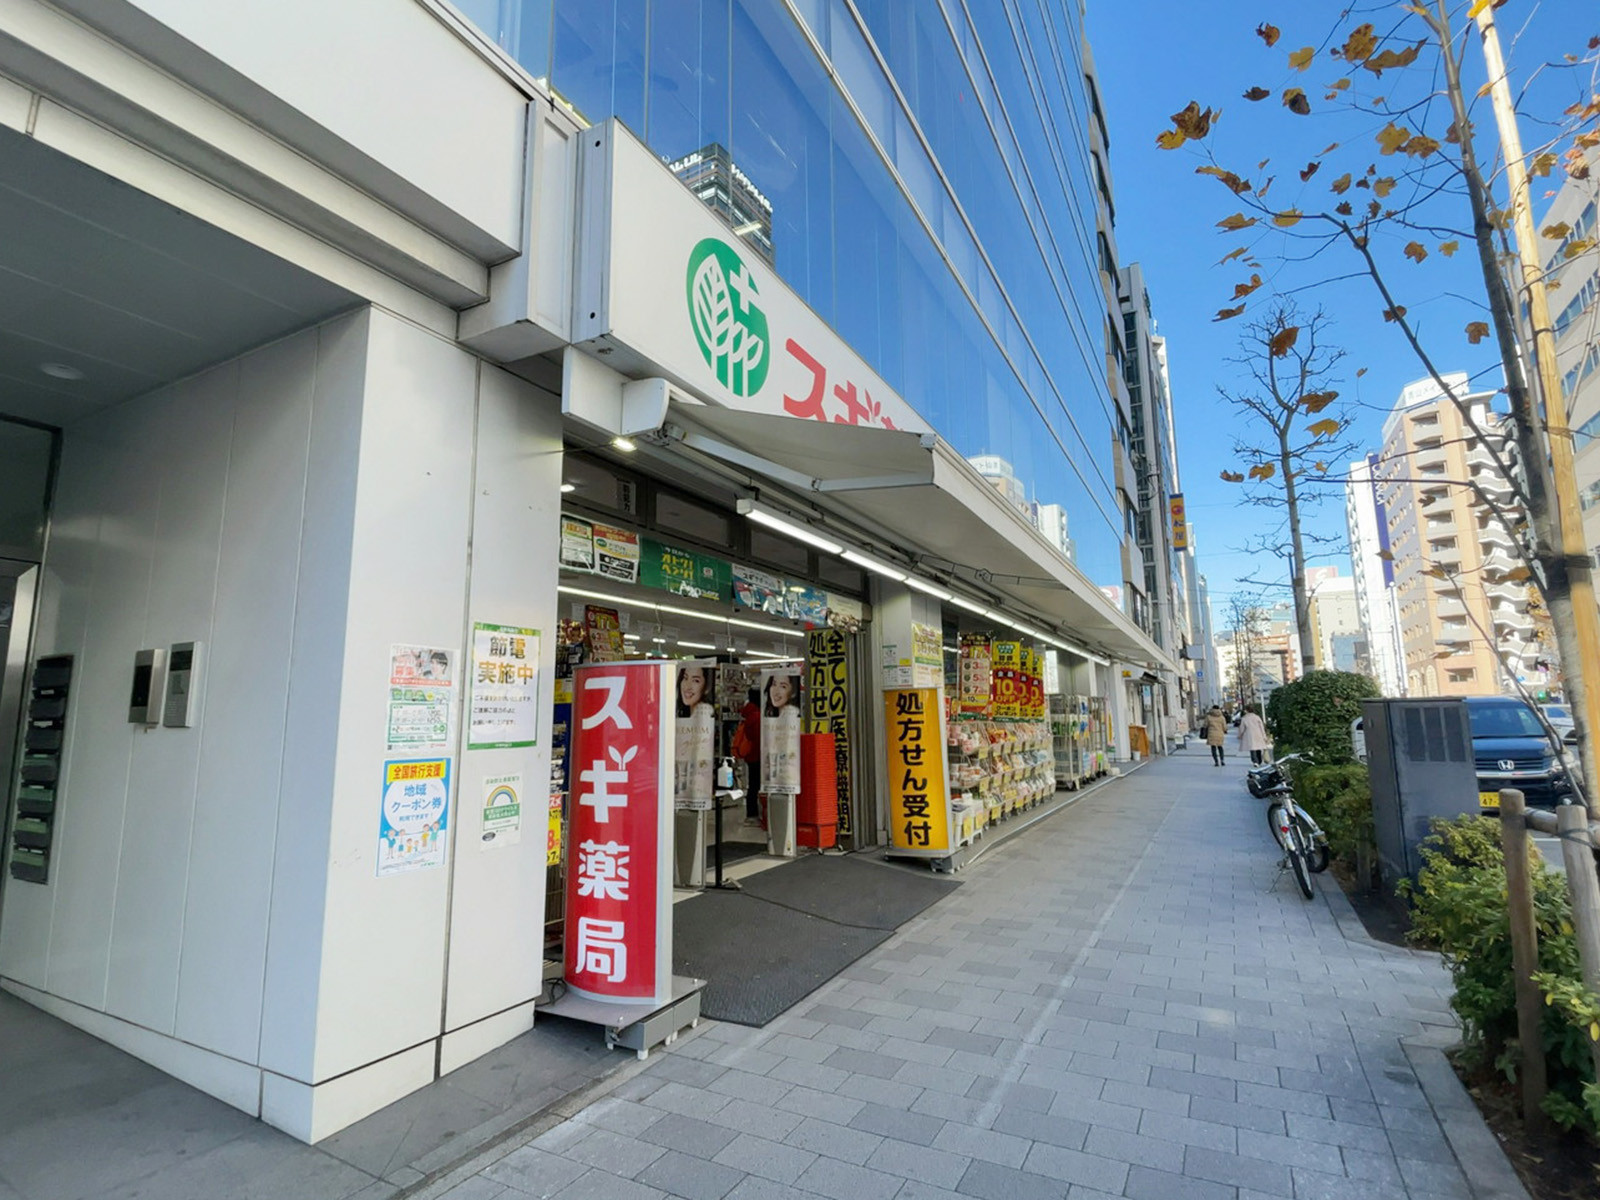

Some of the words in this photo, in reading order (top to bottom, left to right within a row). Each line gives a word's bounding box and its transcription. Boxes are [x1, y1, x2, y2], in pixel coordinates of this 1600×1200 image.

[784, 338, 903, 431] スギ
[489, 636, 526, 659] 節電
[477, 660, 534, 685] 実施中
[393, 763, 441, 780] 全国旅行支援
[896, 692, 932, 846] 処方せん受付
[404, 783, 427, 797] 地域
[391, 796, 442, 813] クーポン券
[576, 676, 637, 983] スギ薬局
